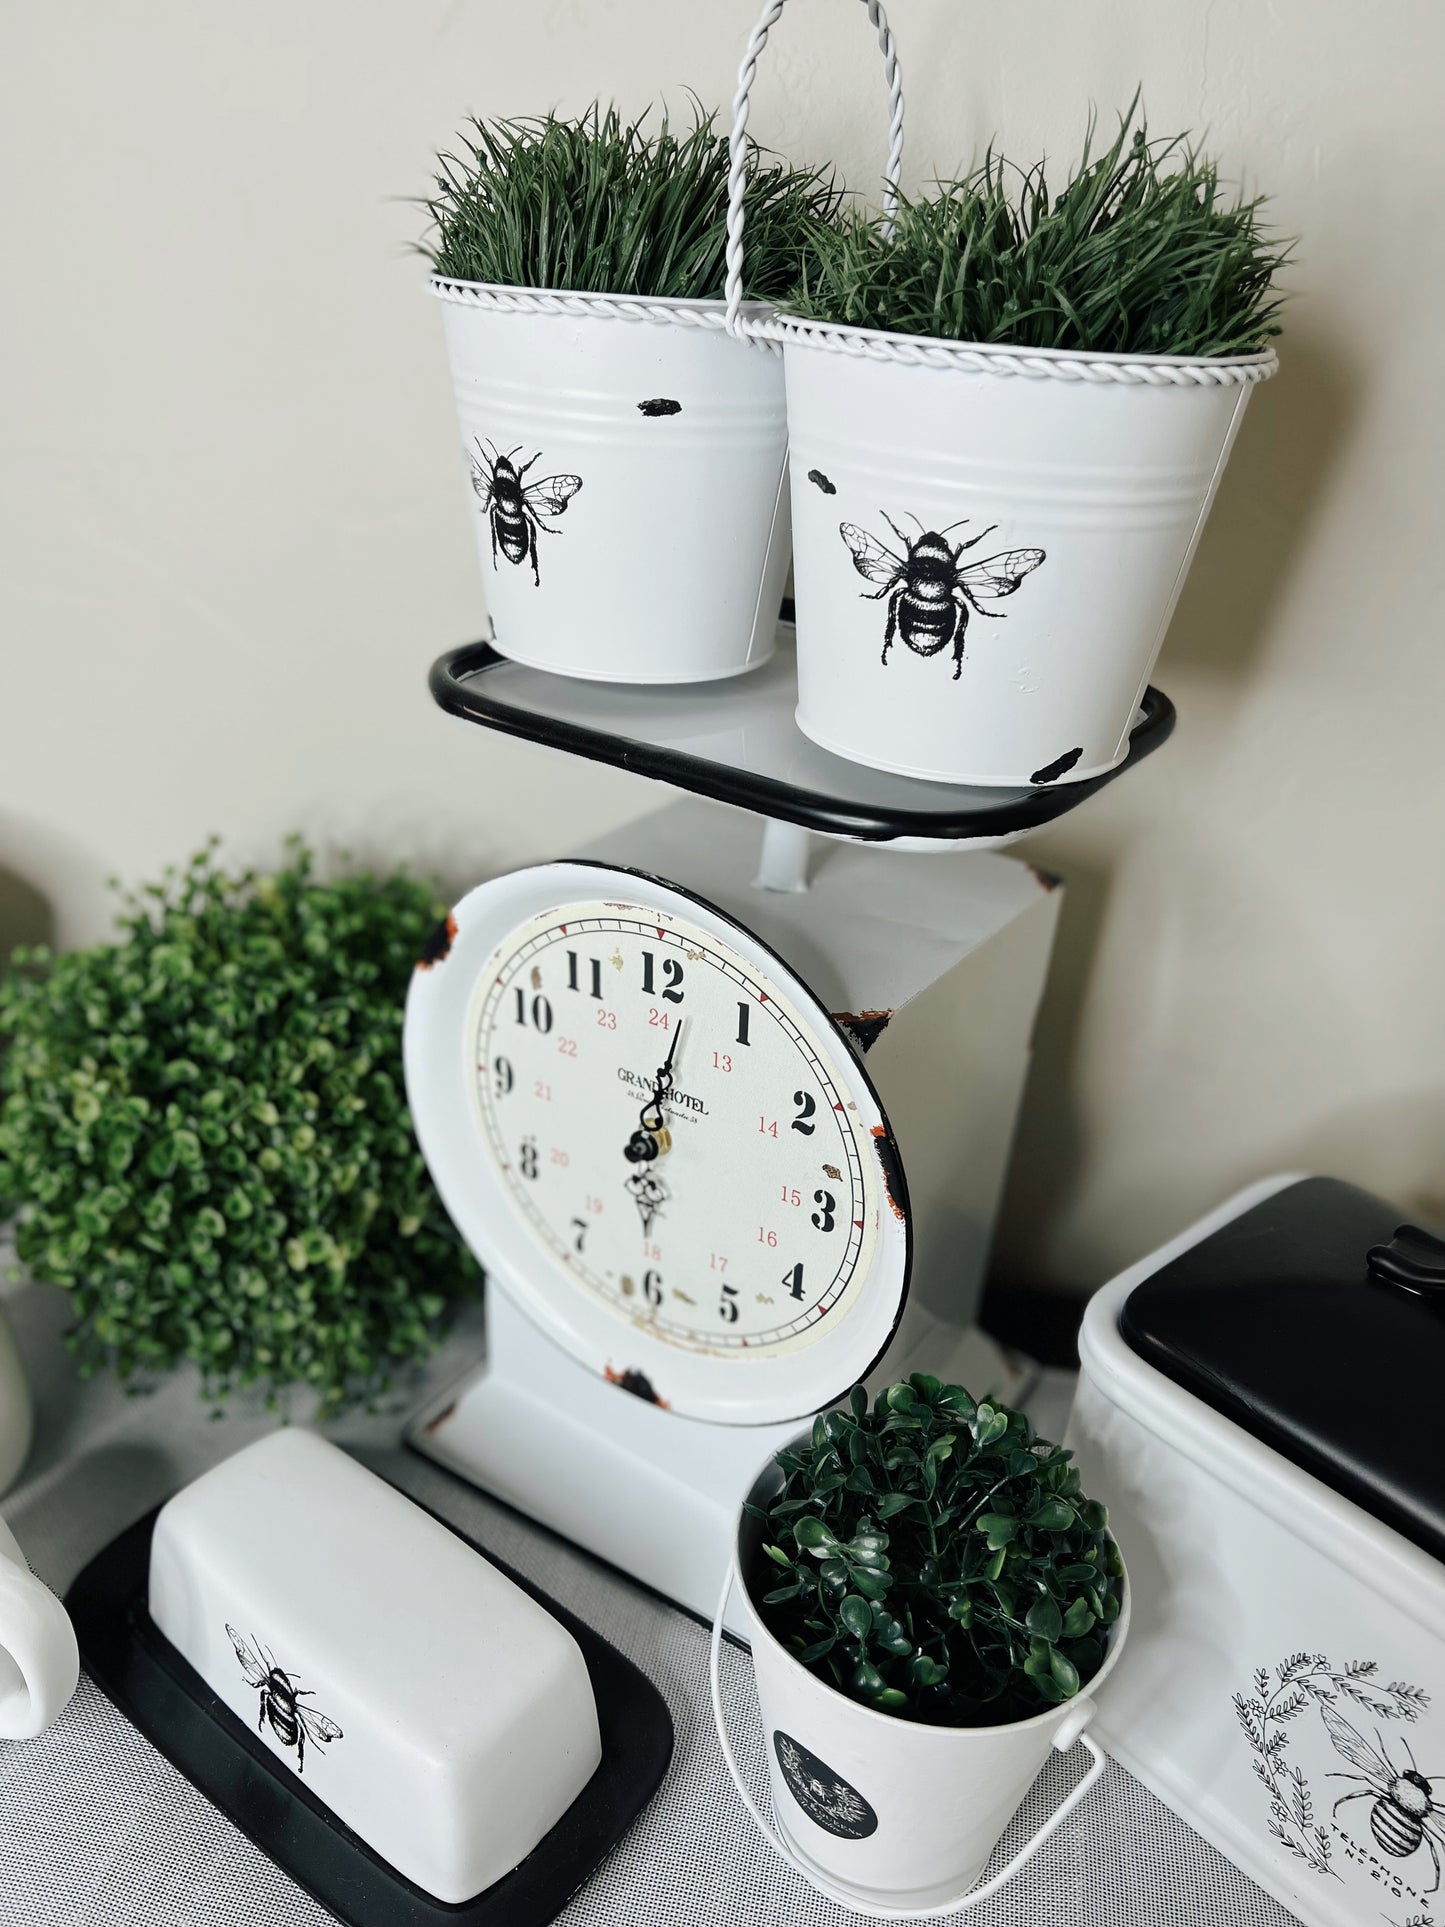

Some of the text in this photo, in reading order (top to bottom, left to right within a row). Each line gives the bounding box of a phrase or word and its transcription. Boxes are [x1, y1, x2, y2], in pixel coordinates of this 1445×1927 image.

[566, 950, 604, 1001] 11
[642, 951, 684, 1004] 12
[514, 988, 553, 1034] 10
[597, 1009, 617, 1031] 23
[648, 1008, 670, 1031] 24
[736, 1002, 750, 1046] 1
[557, 1036, 579, 1058] 22
[712, 1051, 733, 1073] 13
[494, 1056, 514, 1095] 9
[534, 1081, 553, 1101] 21
[618, 1068, 661, 1093] GRAND
[665, 1088, 709, 1116] HOTEL
[758, 1116, 779, 1139] 14
[791, 1091, 816, 1135] 2
[520, 1143, 539, 1180] 8
[780, 1185, 801, 1207] 15
[811, 1190, 835, 1232] 3
[572, 1218, 588, 1252] 7
[644, 1240, 662, 1261] 18
[757, 1227, 777, 1248] 16
[709, 1253, 728, 1273] 17
[644, 1271, 662, 1305] 6
[782, 1263, 806, 1301] 4
[720, 1285, 738, 1322] 5
